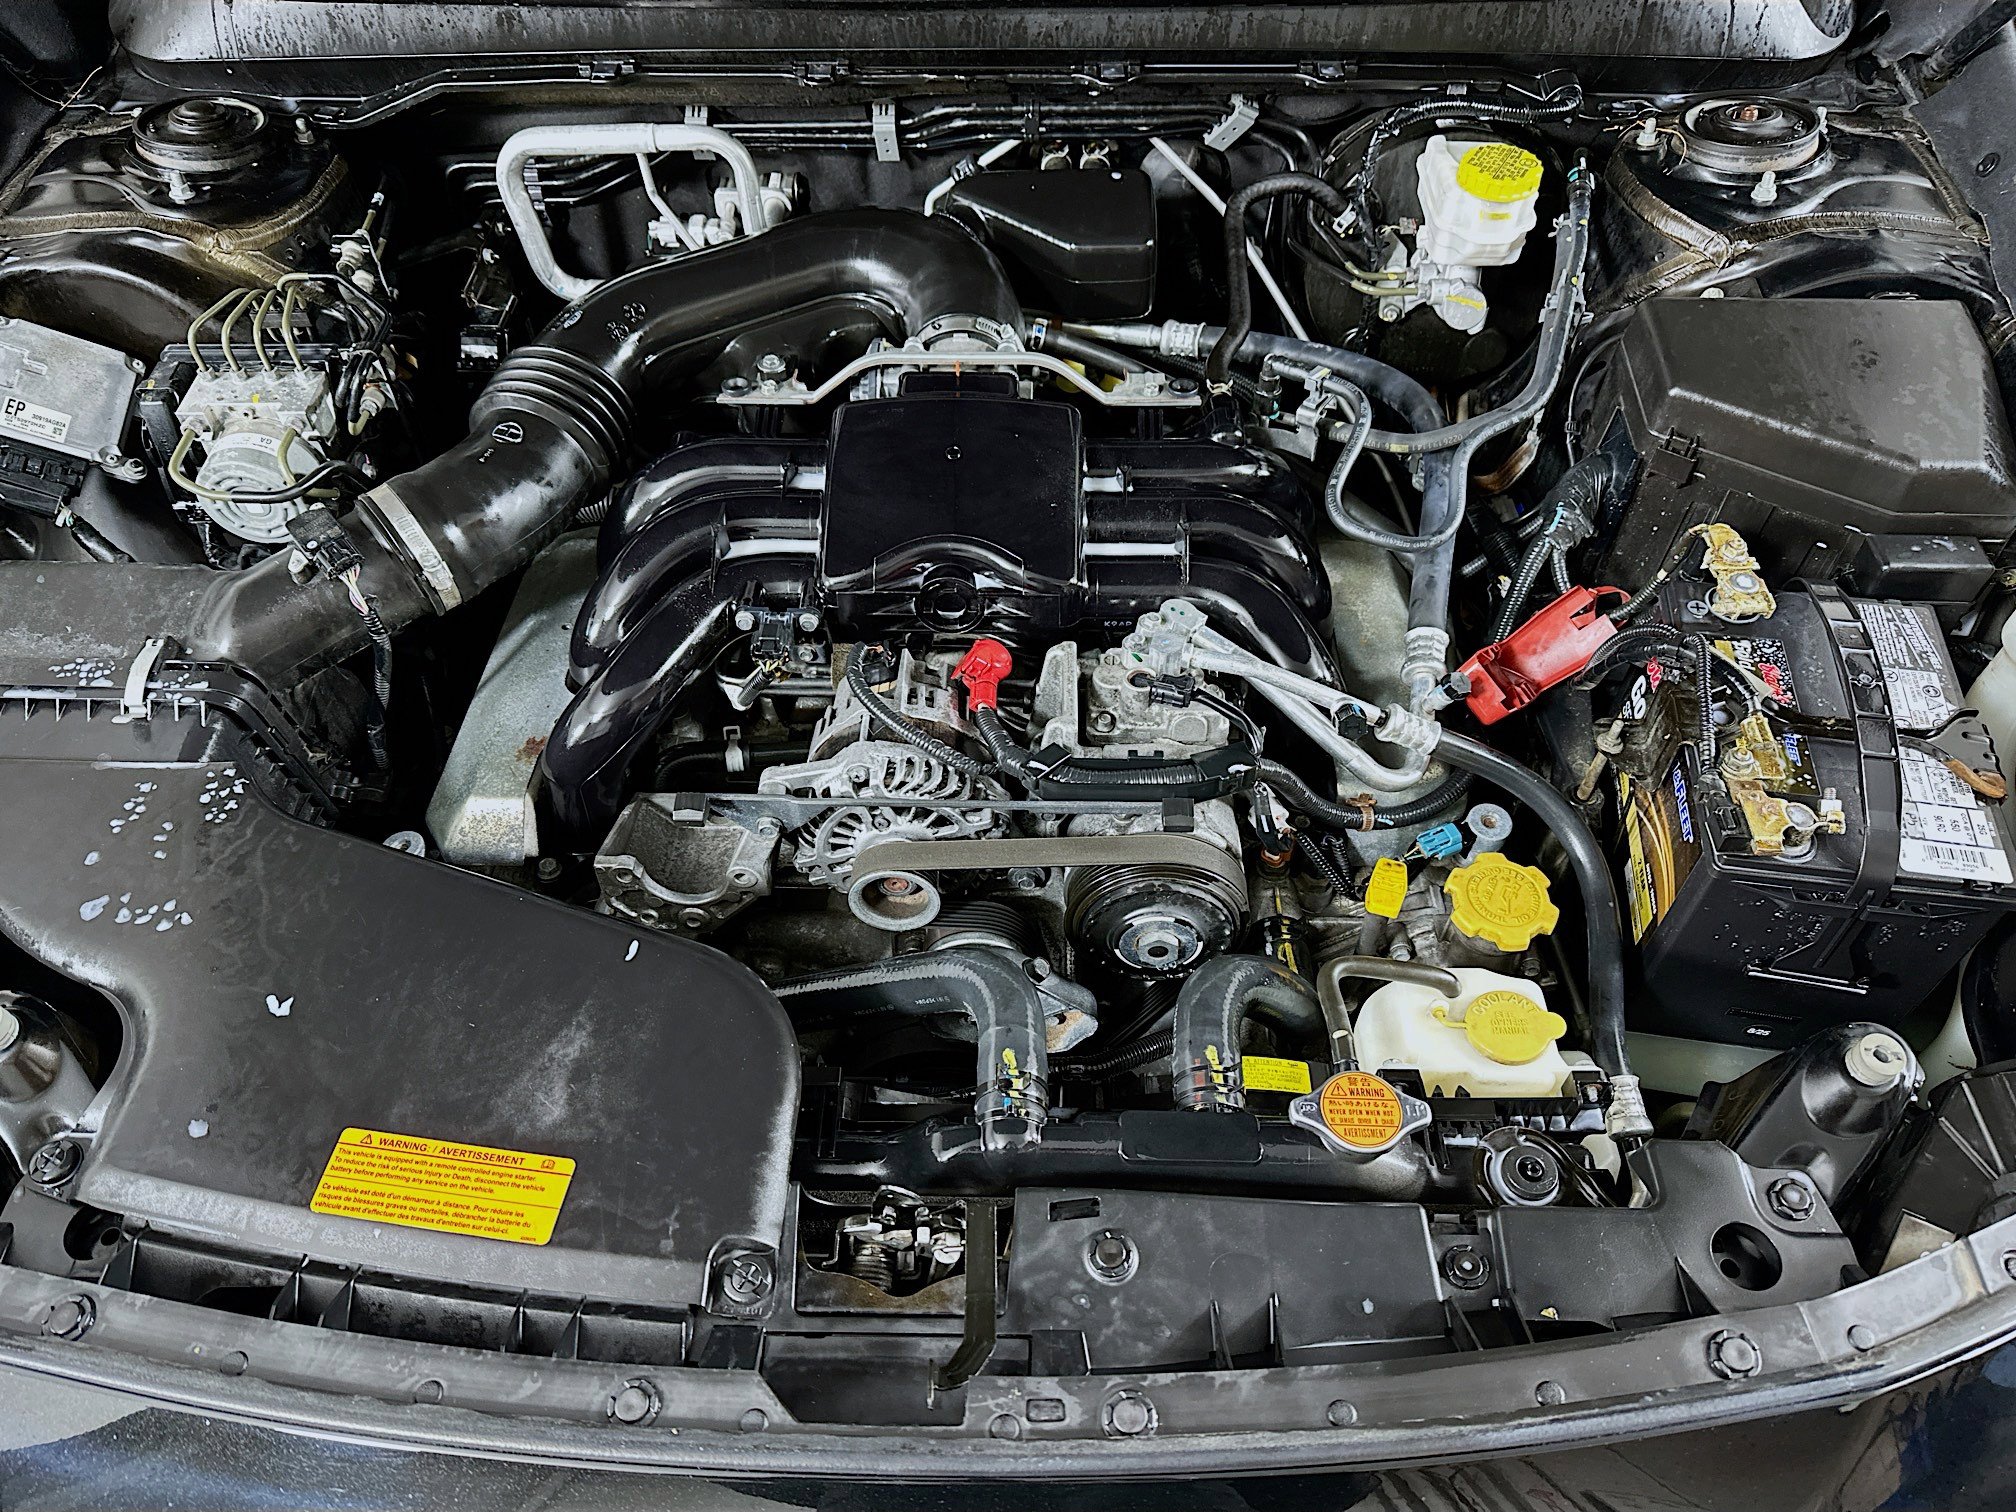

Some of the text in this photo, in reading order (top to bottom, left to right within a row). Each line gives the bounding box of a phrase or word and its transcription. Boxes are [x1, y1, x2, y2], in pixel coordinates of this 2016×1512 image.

[4, 398, 26, 416] EP
[1472, 992, 1541, 1016] COOLANT
[1347, 1076, 1371, 1087] 警告
[1348, 1088, 1385, 1098] WARNING
[1329, 1108, 1346, 1116] NEVER
[1343, 1128, 1387, 1138] AVERTISSMENT
[379, 1137, 430, 1152] WARNING:
[438, 1146, 526, 1166] AVERTISSEMENT
[343, 1158, 366, 1166] reduce
[366, 1160, 376, 1168] the
[378, 1162, 390, 1170] risk
[400, 1166, 423, 1175] serious
[474, 1177, 510, 1188] disconnect
[510, 1180, 521, 1188] the
[522, 1182, 546, 1192] vehicle
[353, 1149, 376, 1160] vehicle
[384, 1154, 414, 1166] equipped
[414, 1158, 428, 1167] with
[434, 1162, 457, 1170] remote
[458, 1164, 490, 1176] controlled
[492, 1170, 513, 1180] engine
[330, 1165, 352, 1174] battery
[354, 1168, 374, 1177] before
[374, 1170, 410, 1183] performing
[424, 1178, 448, 1188] service
[472, 1184, 495, 1194] vehicle.
[314, 1200, 342, 1210] véhicule
[397, 1212, 409, 1220] des
[410, 1214, 434, 1224] travaux
[318, 1192, 342, 1202] risques
[353, 1197, 384, 1207] blessures
[385, 1202, 408, 1211] graves
[452, 1211, 488, 1222] débrancher
[496, 1216, 521, 1227] batterie
[322, 1182, 331, 1190] Ce
[332, 1184, 359, 1194] véhicule
[360, 1188, 370, 1196] est
[371, 1190, 386, 1198] doté
[402, 1194, 436, 1205] démarreur
[473, 1204, 489, 1213] Pour
[490, 1206, 514, 1216] réduire
[514, 1210, 524, 1218] les
